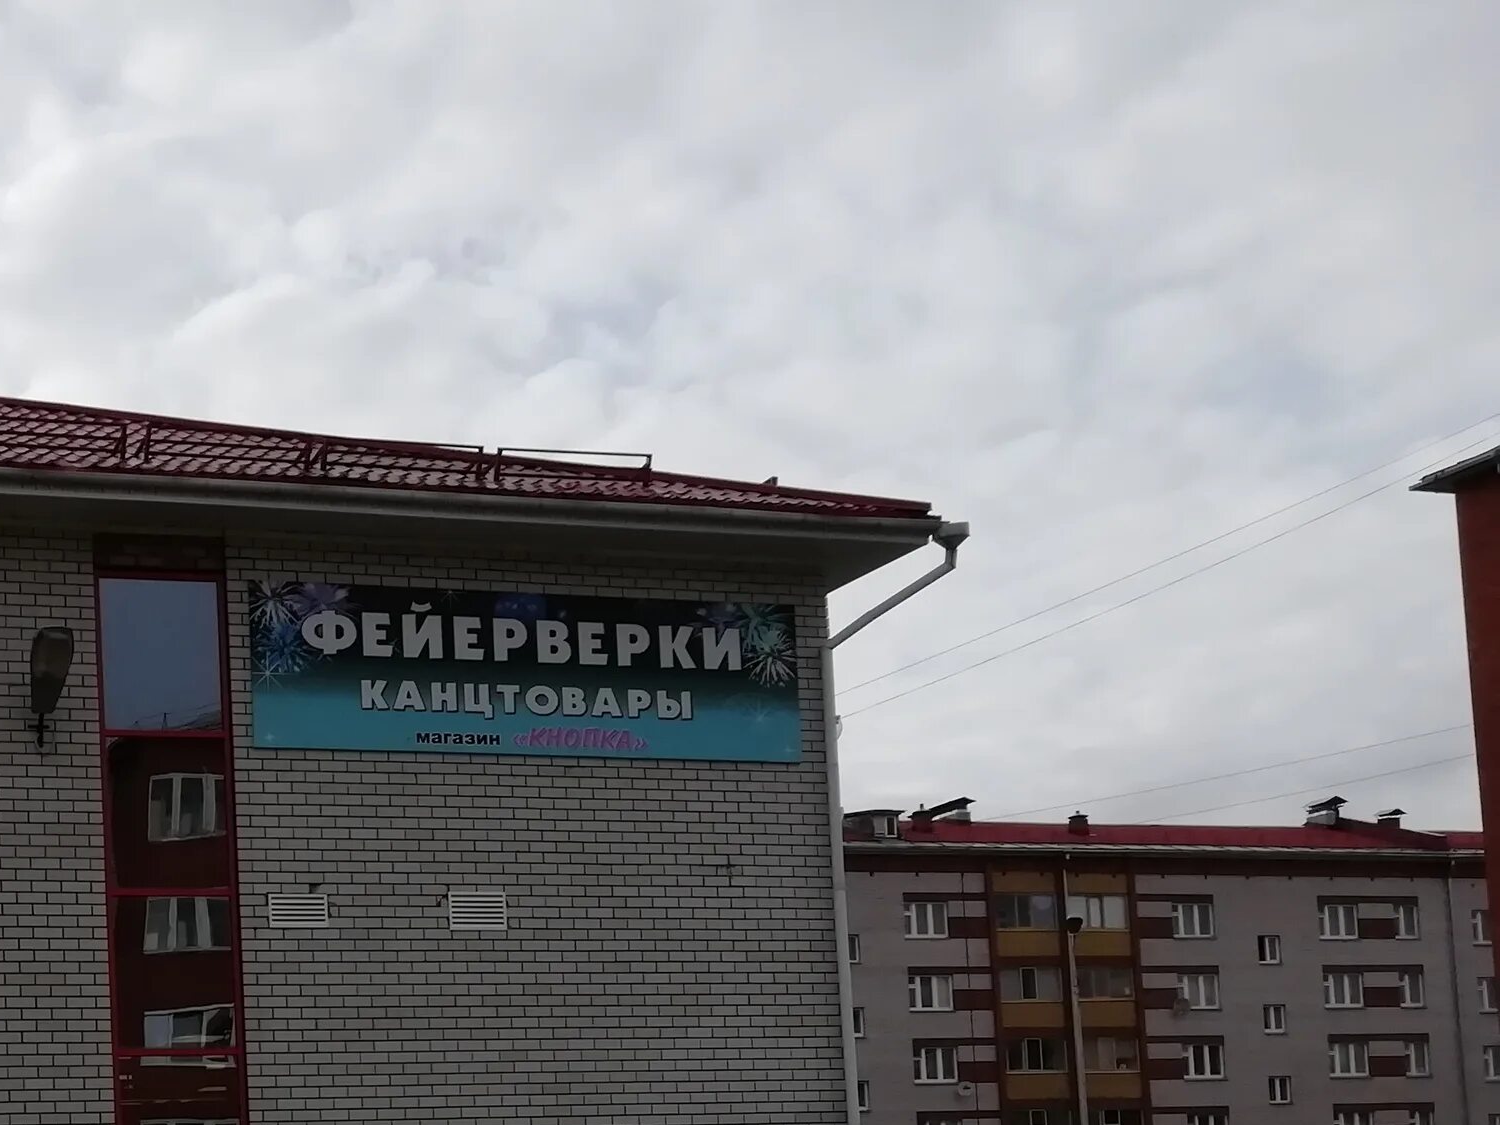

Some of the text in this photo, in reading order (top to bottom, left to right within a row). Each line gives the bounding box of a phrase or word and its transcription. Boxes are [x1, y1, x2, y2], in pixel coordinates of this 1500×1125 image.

[300, 601, 743, 672] ФЕЙЕРВЕРКИ
[360, 678, 695, 721] КАНЦТОВАРЫ
[416, 731, 501, 746] магазин
